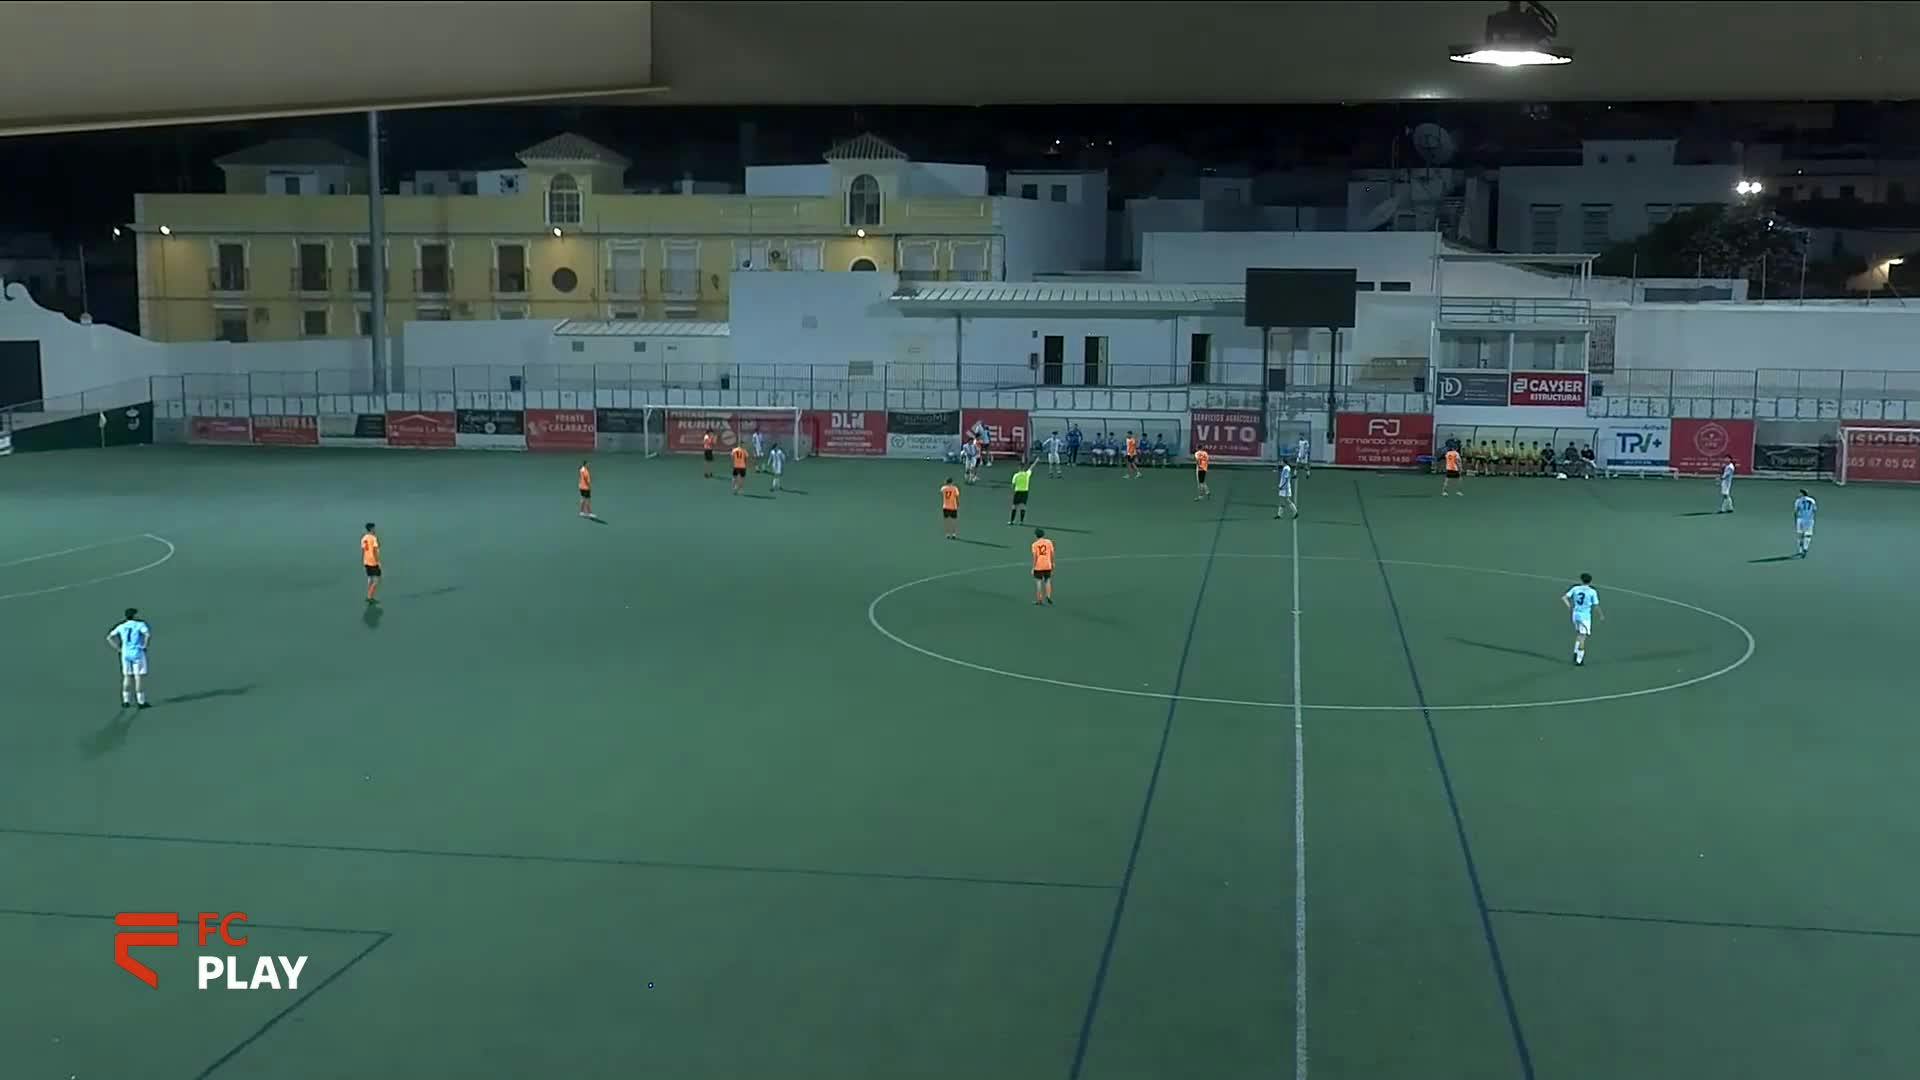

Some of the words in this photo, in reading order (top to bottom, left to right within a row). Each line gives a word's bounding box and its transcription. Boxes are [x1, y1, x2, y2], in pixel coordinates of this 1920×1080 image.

[1529, 379, 1583, 393] CAYSER
[1530, 393, 1582, 402] ESTRUCTURAS
[555, 414, 585, 422] FRENTE
[831, 412, 865, 429] DLM
[1196, 425, 1257, 442] VITO
[1576, 592, 1586, 606] 3
